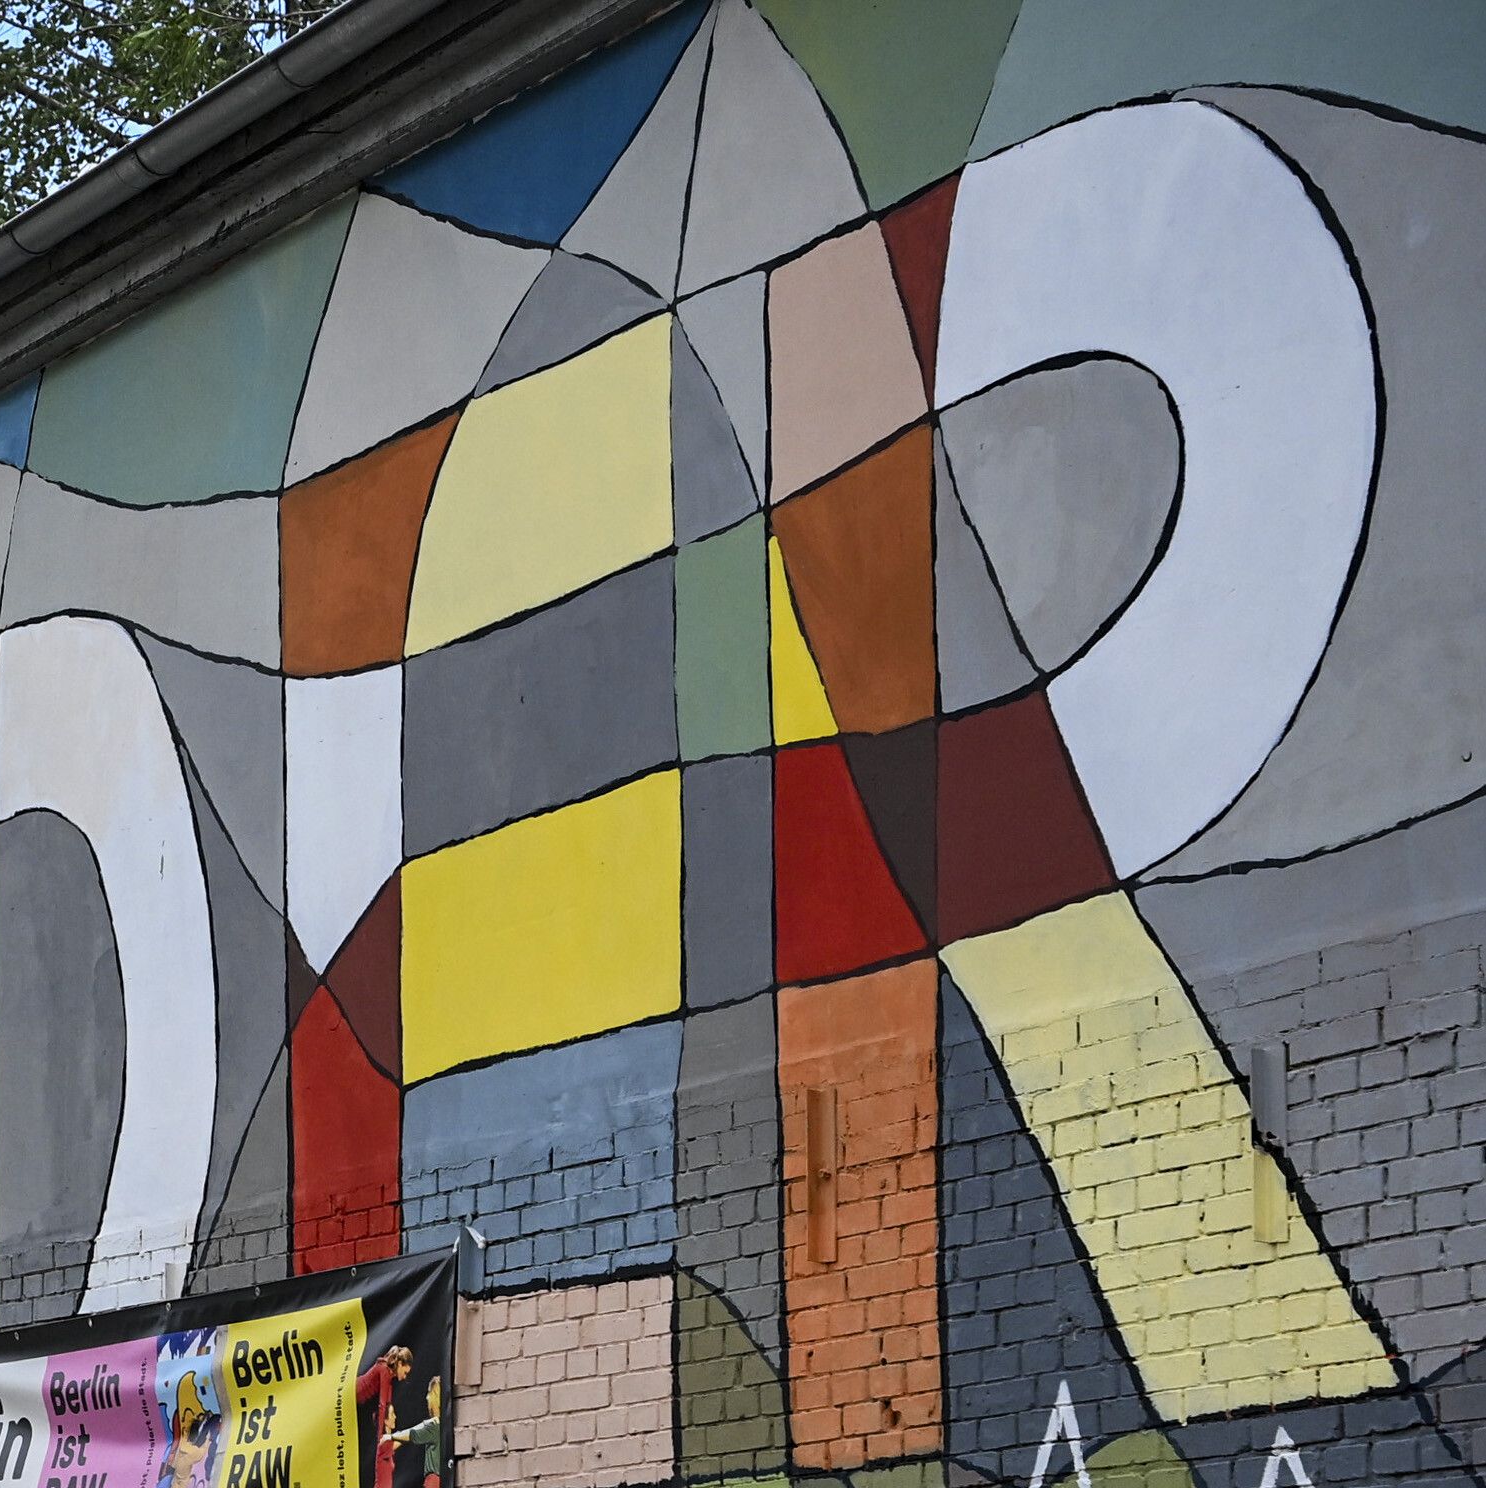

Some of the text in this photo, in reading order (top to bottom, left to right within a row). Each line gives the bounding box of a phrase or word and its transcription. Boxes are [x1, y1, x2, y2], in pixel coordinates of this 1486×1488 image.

[232, 1329, 323, 1388] Berlin
[50, 1364, 121, 1416] Berlin
[236, 1395, 277, 1445] ist
[51, 1424, 90, 1469] ist
